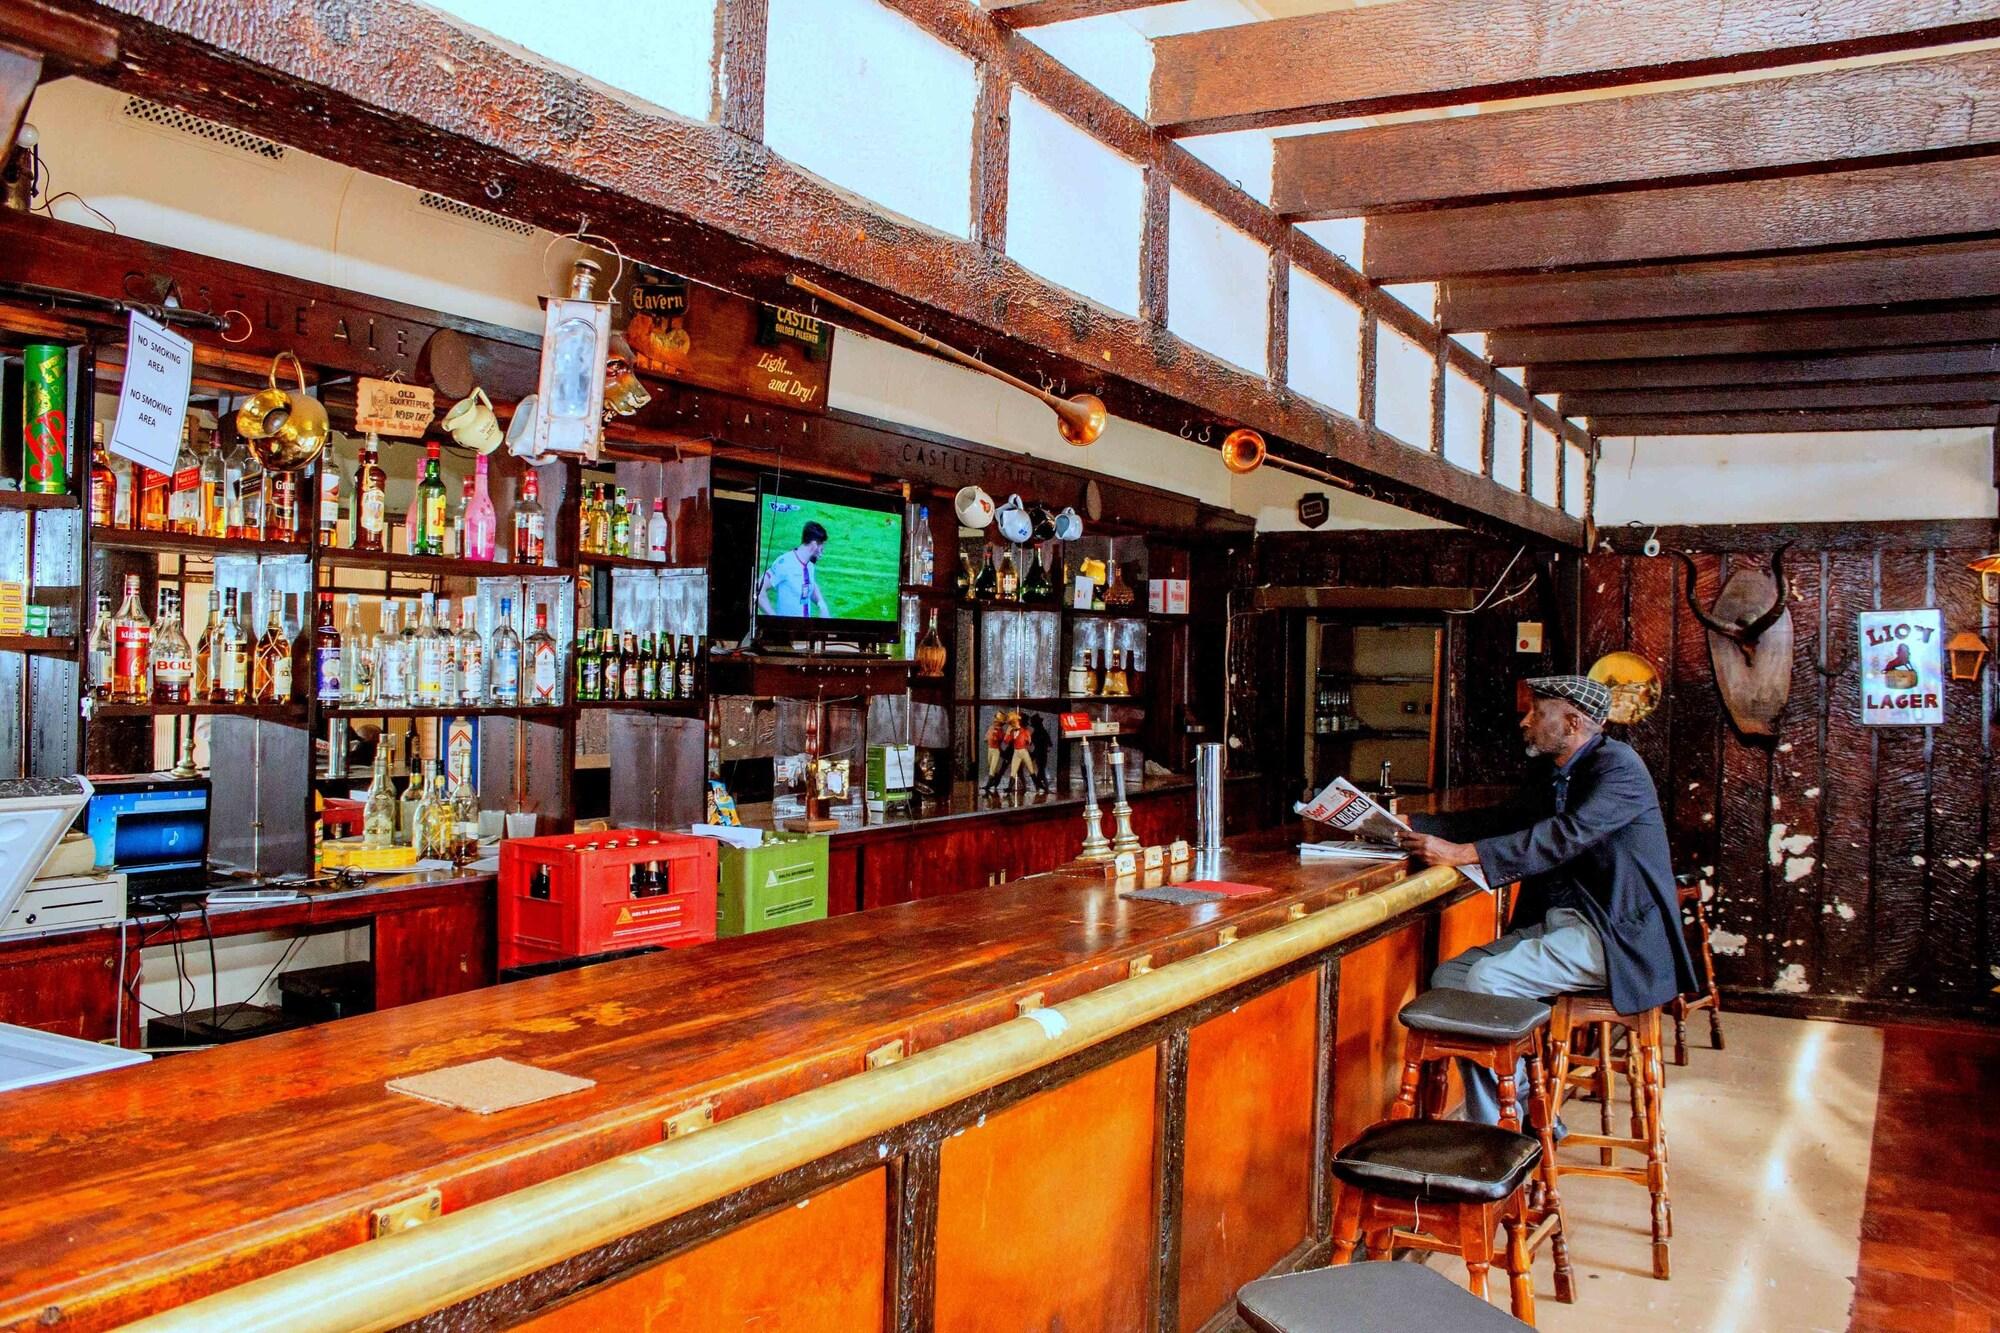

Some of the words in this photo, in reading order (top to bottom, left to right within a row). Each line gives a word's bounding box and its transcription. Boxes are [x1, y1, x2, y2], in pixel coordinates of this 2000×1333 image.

[632, 287, 684, 311] Tavern
[777, 307, 819, 333] CASTLE
[137, 335, 148, 347] NO
[150, 342, 181, 365] SMOKING
[332, 318, 408, 358] ALE
[147, 359, 165, 374] AREA
[129, 388, 141, 401] NO
[141, 393, 173, 416] SMOKING
[398, 390, 416, 399] OLD
[768, 378, 787, 393] and
[789, 380, 818, 403] Dry!
[138, 412, 156, 428] AREA
[394, 410, 414, 421] NEVER
[902, 443, 971, 475] CASTLE
[1867, 694, 1938, 709] LAGER
[1336, 797, 1370, 825] RUFARO
